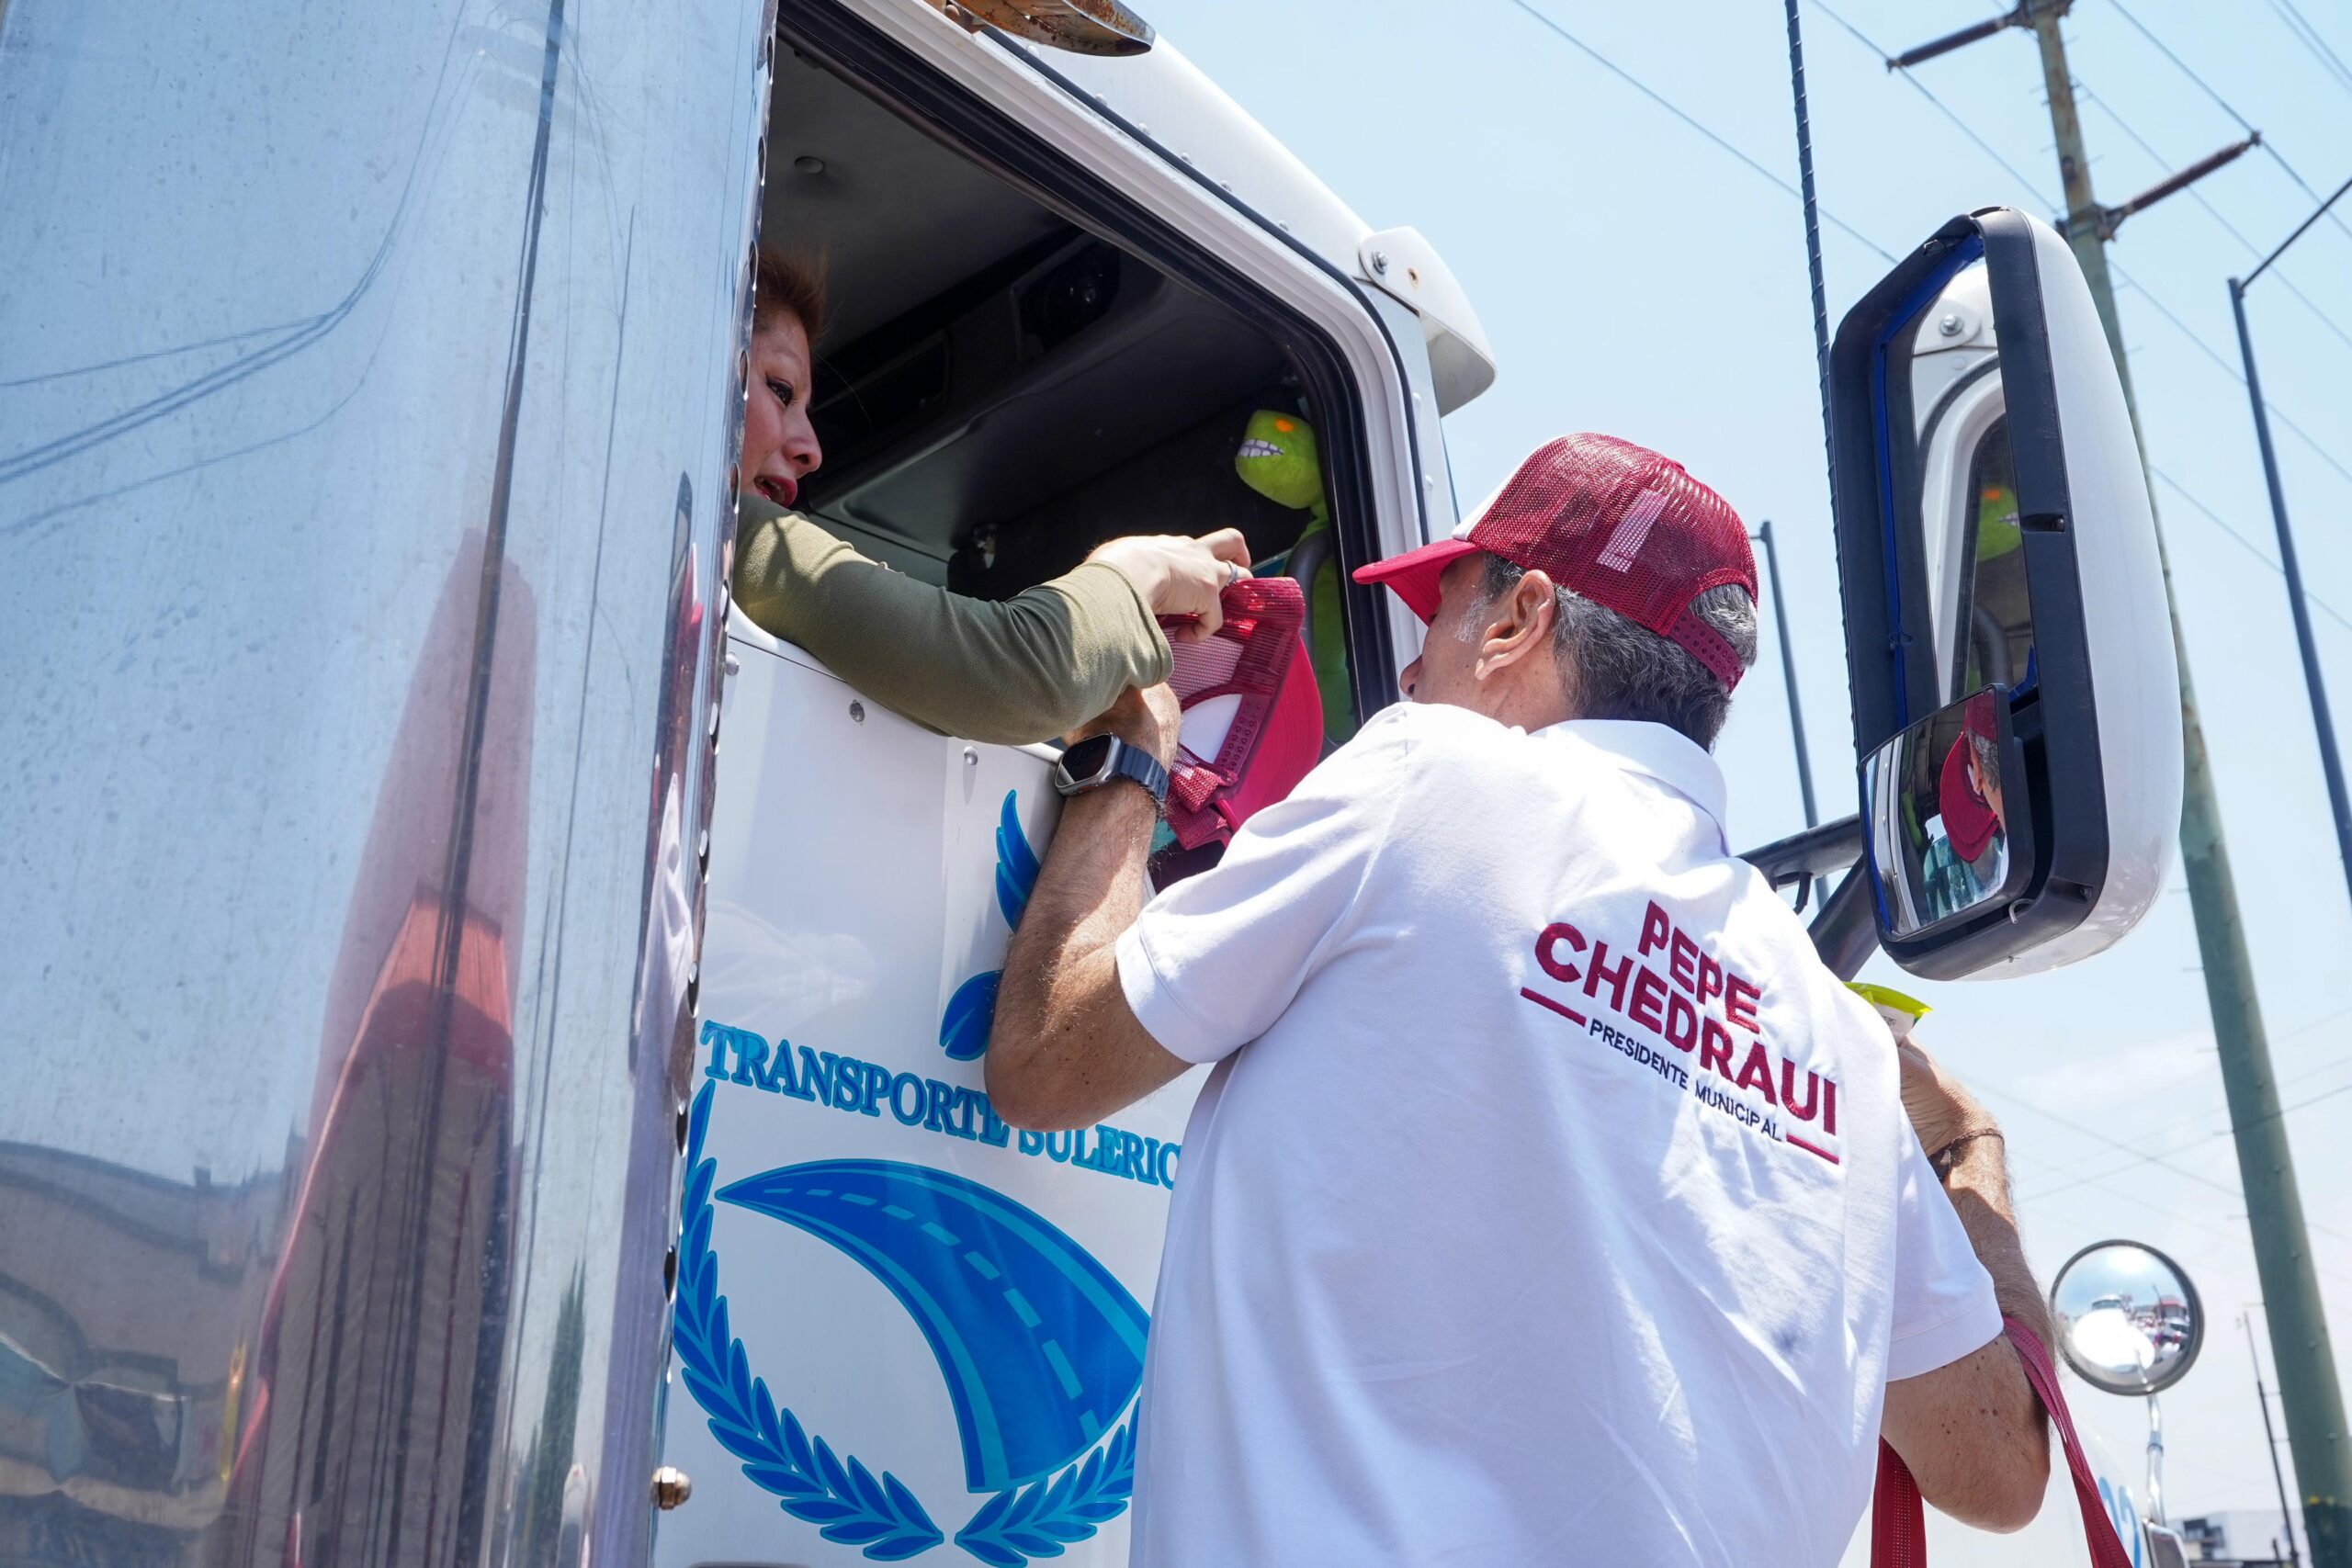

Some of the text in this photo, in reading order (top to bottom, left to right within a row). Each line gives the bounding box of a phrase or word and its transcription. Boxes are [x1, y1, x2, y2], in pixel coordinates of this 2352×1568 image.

[1534, 922, 1837, 1135] CHEDRAUI
[1638, 899, 1761, 1034] PEPE
[700, 1020, 1010, 1148] TRANSPORTE
[1589, 1019, 1782, 1142] PRESIDENTE MUNICIPAL
